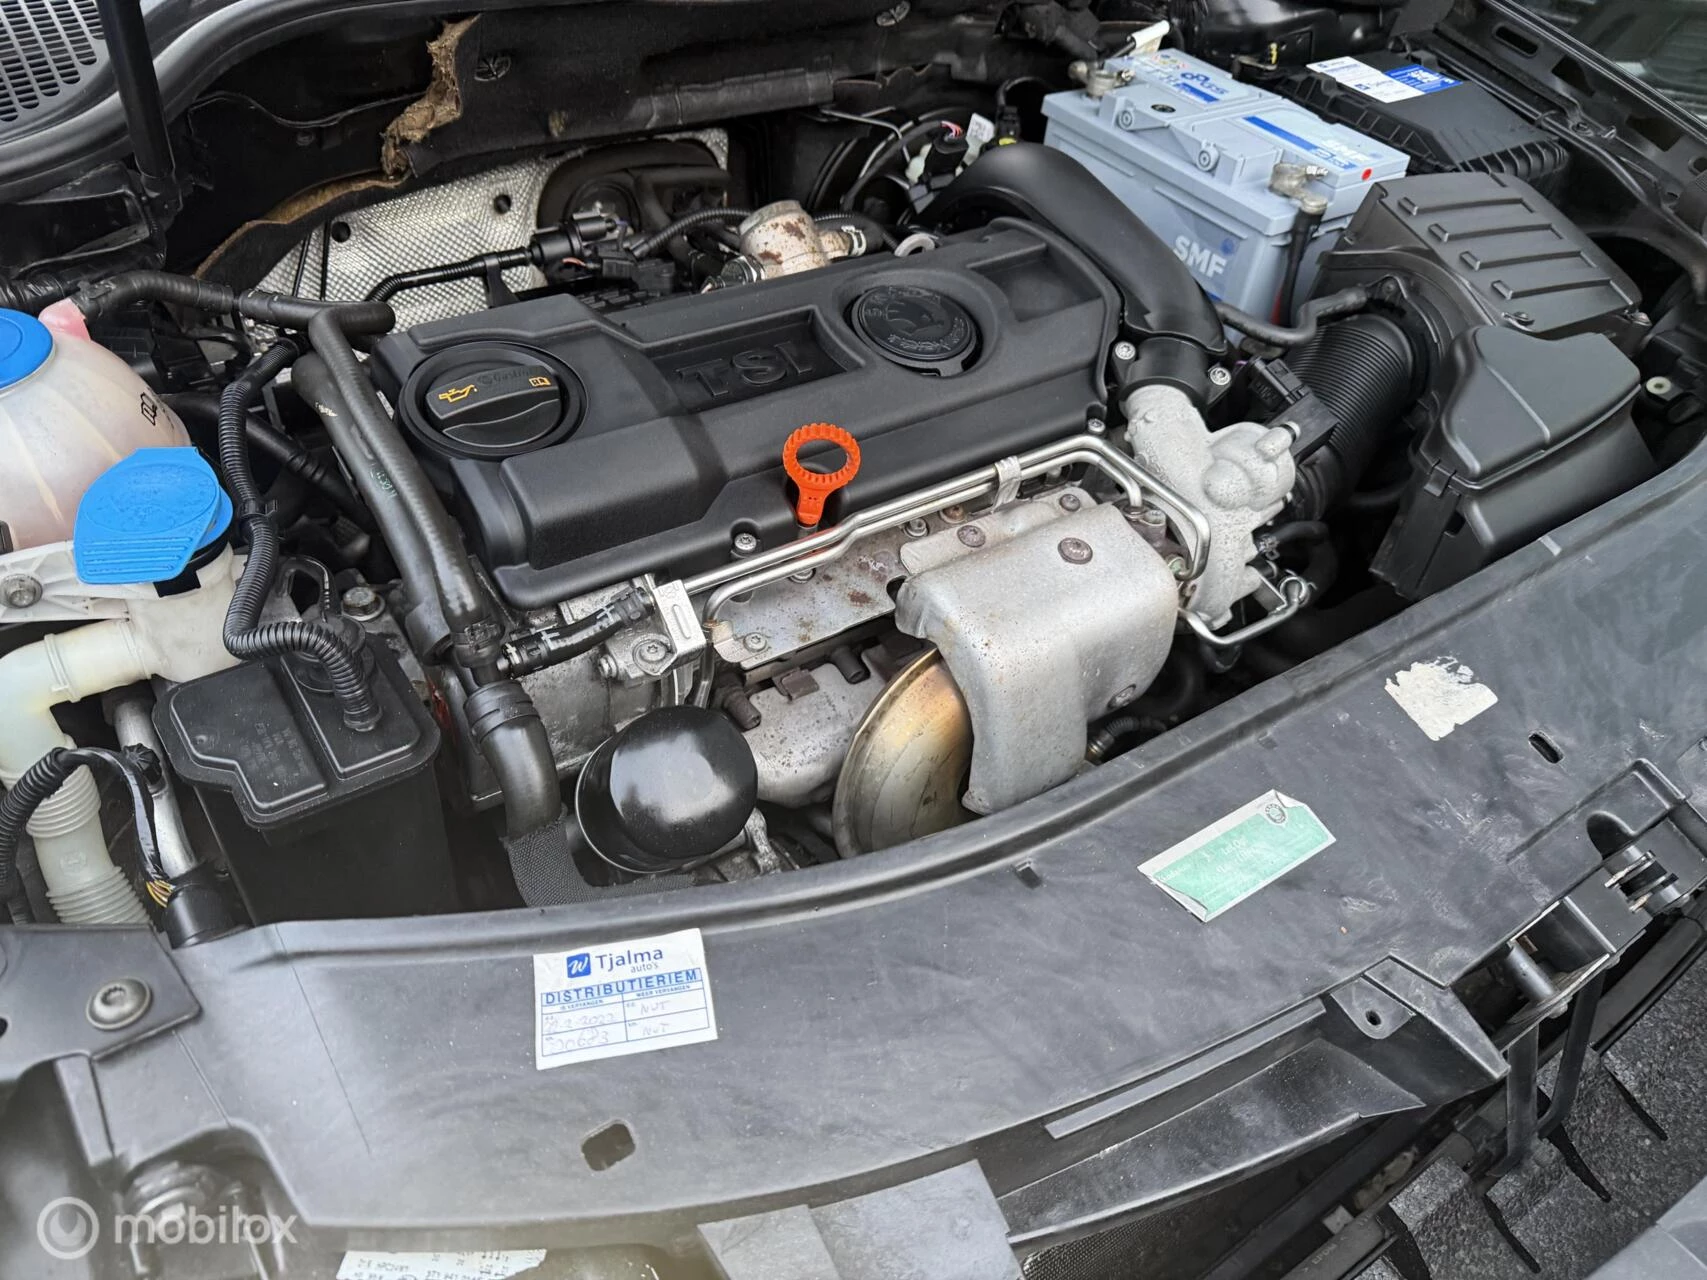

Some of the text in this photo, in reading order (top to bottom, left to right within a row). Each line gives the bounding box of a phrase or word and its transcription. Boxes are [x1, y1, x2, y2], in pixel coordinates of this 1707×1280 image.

[1173, 235, 1227, 278] SMF
[676, 341, 813, 396] TSI
[595, 948, 664, 972] Tjalma
[630, 961, 660, 974] auto's
[545, 969, 699, 1005] DISTRIBUTIERIEM
